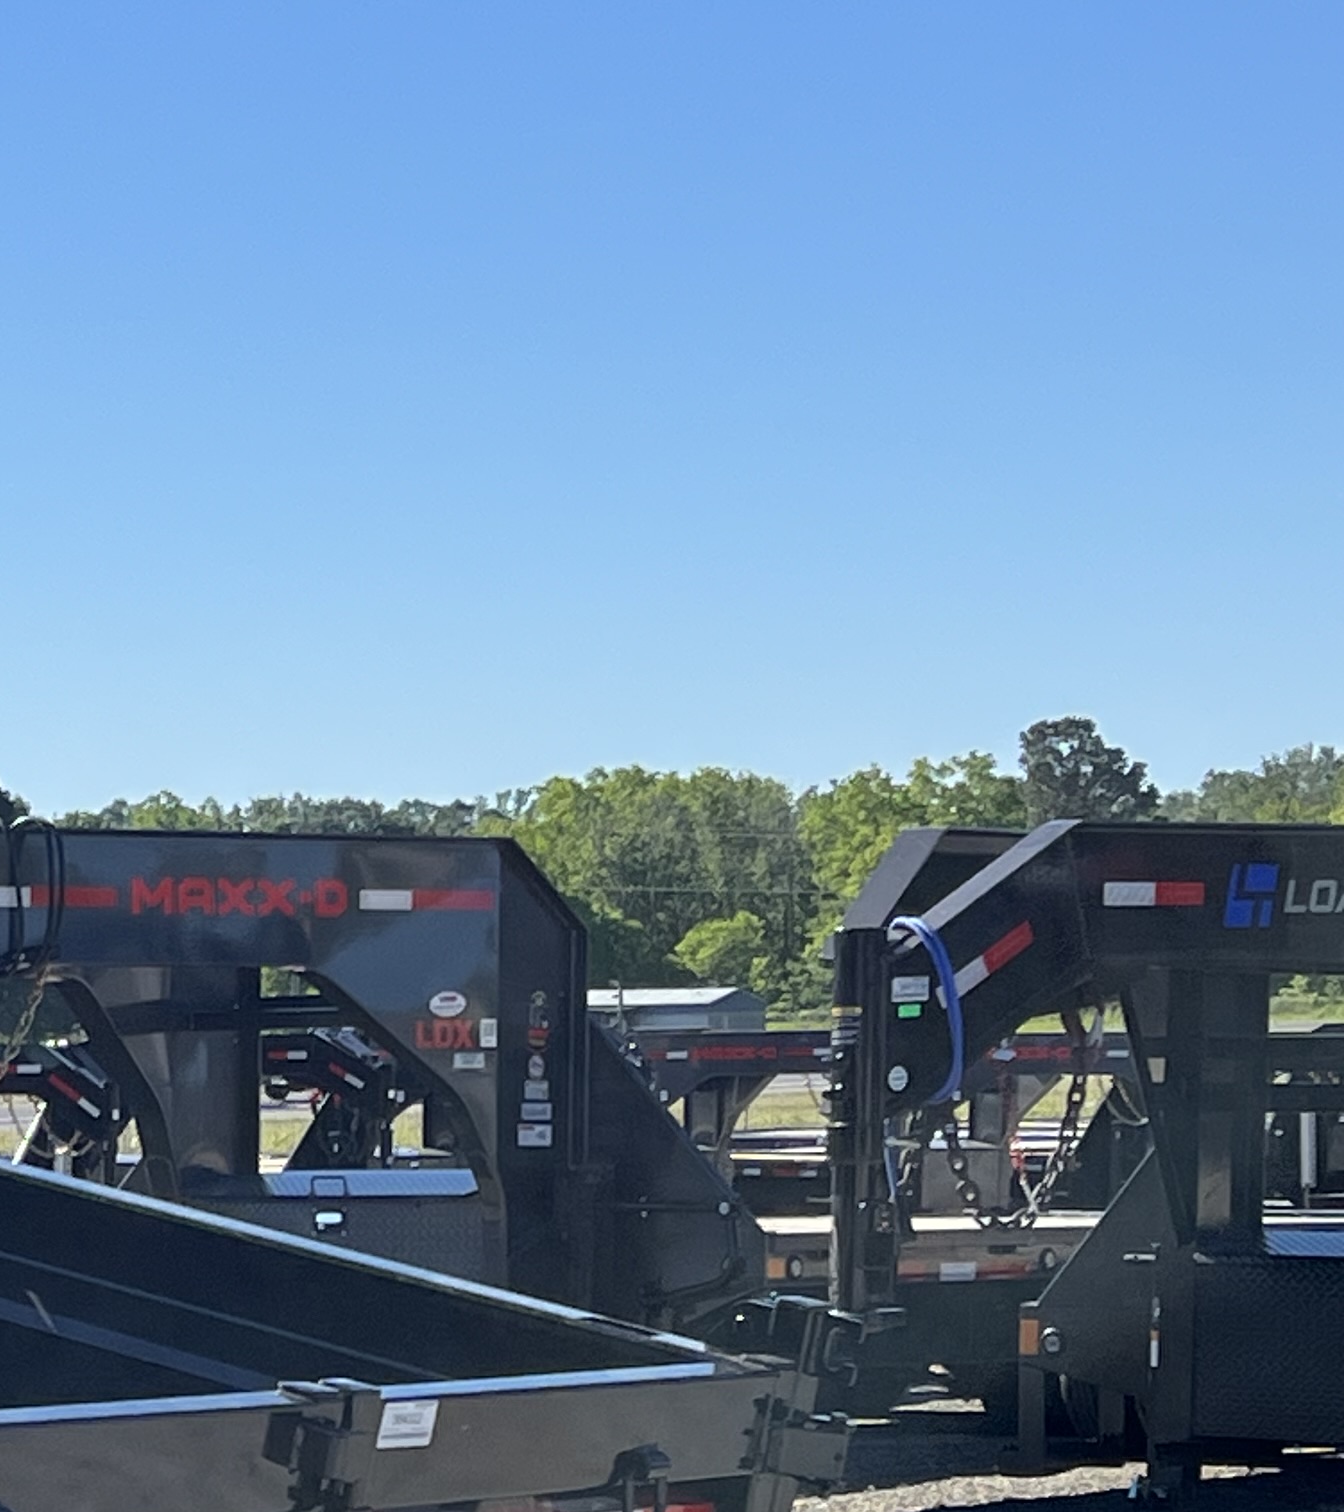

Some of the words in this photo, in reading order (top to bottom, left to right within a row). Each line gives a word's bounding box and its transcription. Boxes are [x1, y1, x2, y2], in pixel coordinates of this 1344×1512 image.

[130, 875, 348, 918] MAXX-D
[1283, 879, 1344, 914] LO
[416, 1020, 475, 1048] LDX
